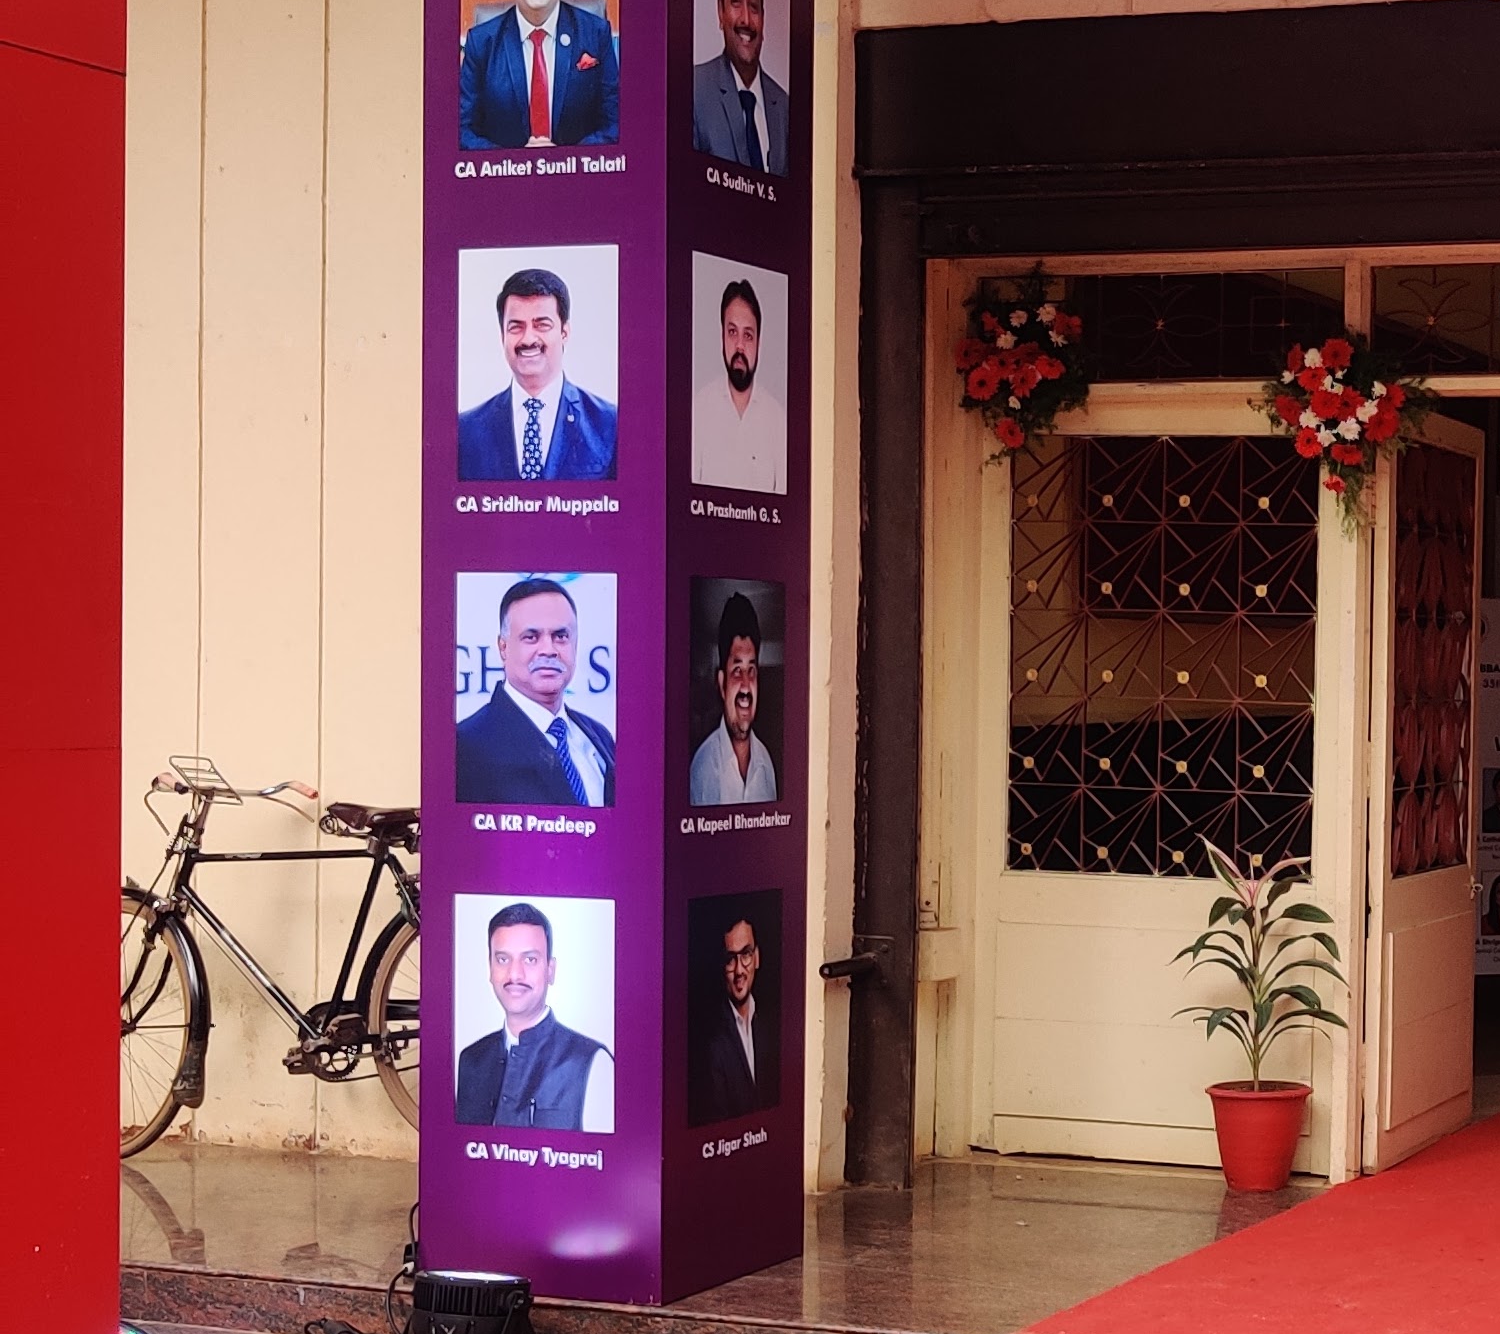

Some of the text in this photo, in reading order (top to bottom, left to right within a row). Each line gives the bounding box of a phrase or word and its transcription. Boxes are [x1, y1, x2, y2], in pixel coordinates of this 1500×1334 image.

[455, 155, 626, 178] CA Aniket Sunil Talati
[707, 167, 777, 202] CA Sudhir V. S.
[456, 496, 619, 516] CA Sridhar Muppala
[690, 500, 781, 524] CA Prashanth G. S.
[474, 814, 596, 837] CA KR Pradeep
[680, 812, 791, 834] CA Kapeel Bhandarkar
[702, 1130, 768, 1159] CS Jigar Shah
[466, 1142, 603, 1172] CA Vinay Tyagraj
